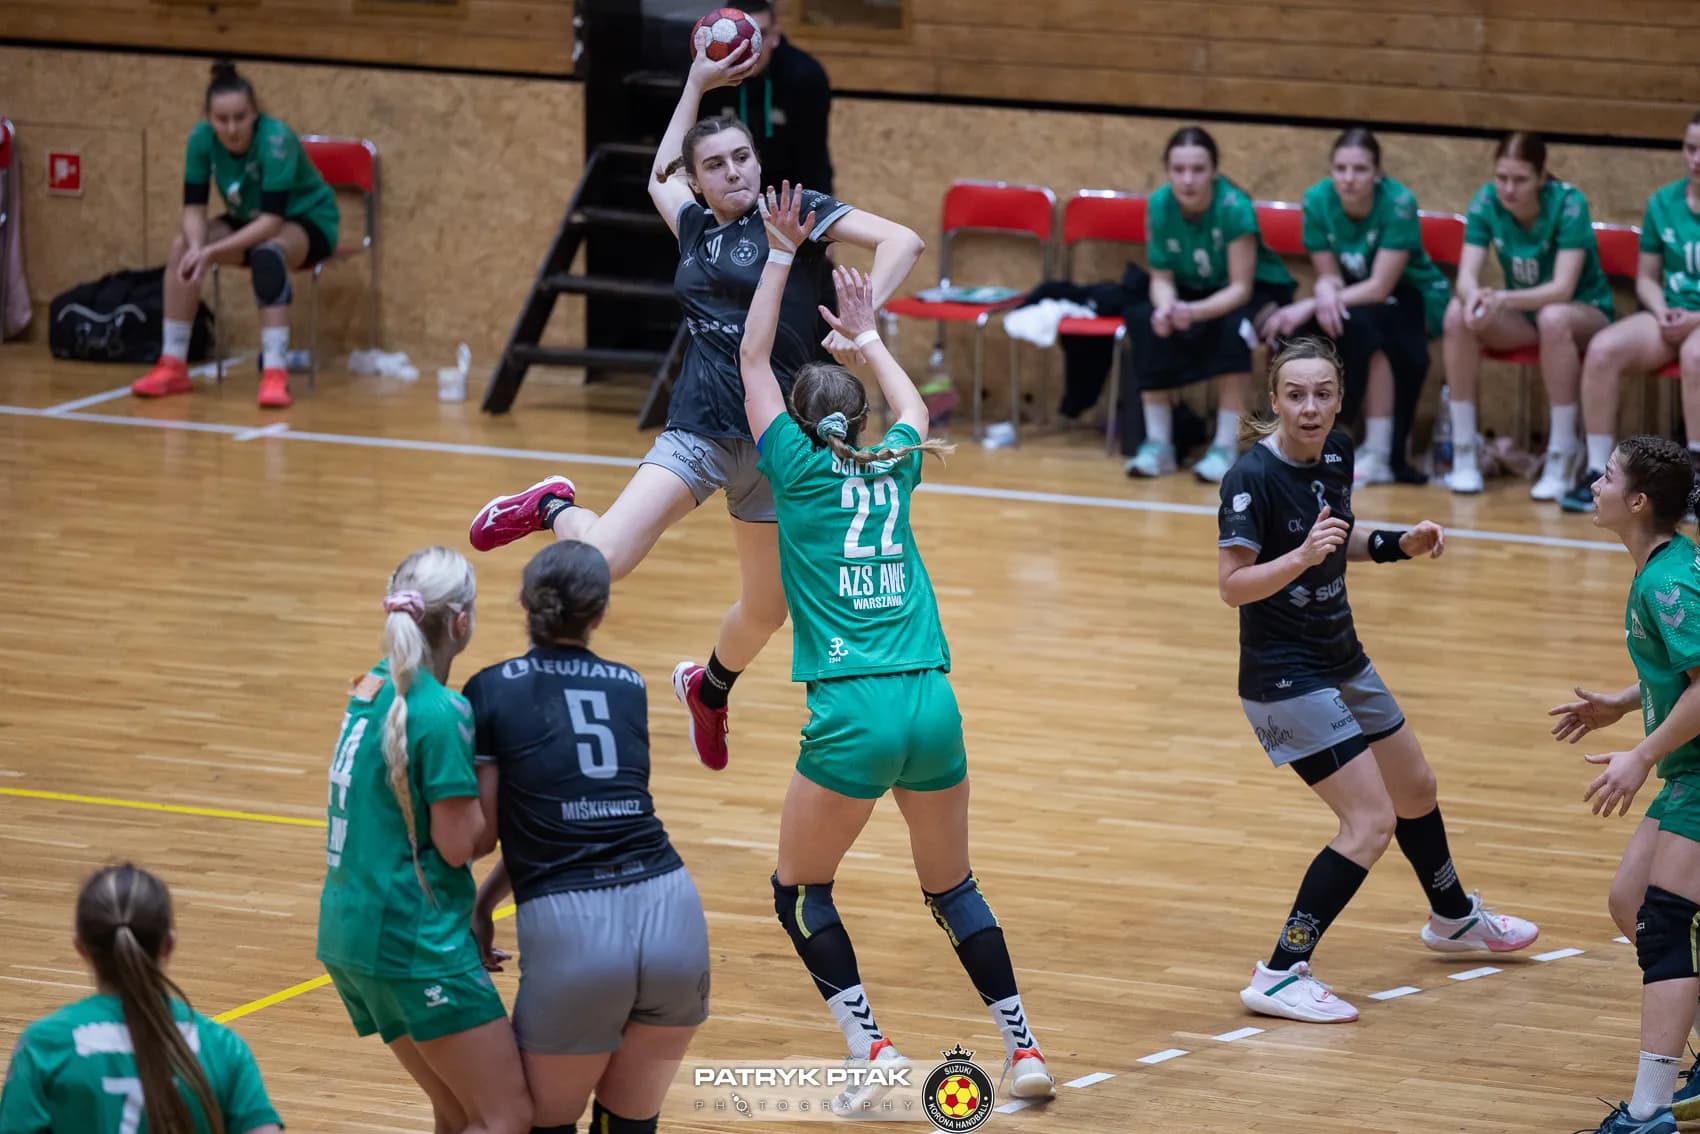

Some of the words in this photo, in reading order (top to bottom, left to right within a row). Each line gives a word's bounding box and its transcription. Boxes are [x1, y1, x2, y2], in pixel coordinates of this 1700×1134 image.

[841, 476, 903, 558] 22
[839, 565, 874, 597] AZS
[564, 689, 618, 779] 5
[562, 796, 643, 820] MIŚKIEWICZ
